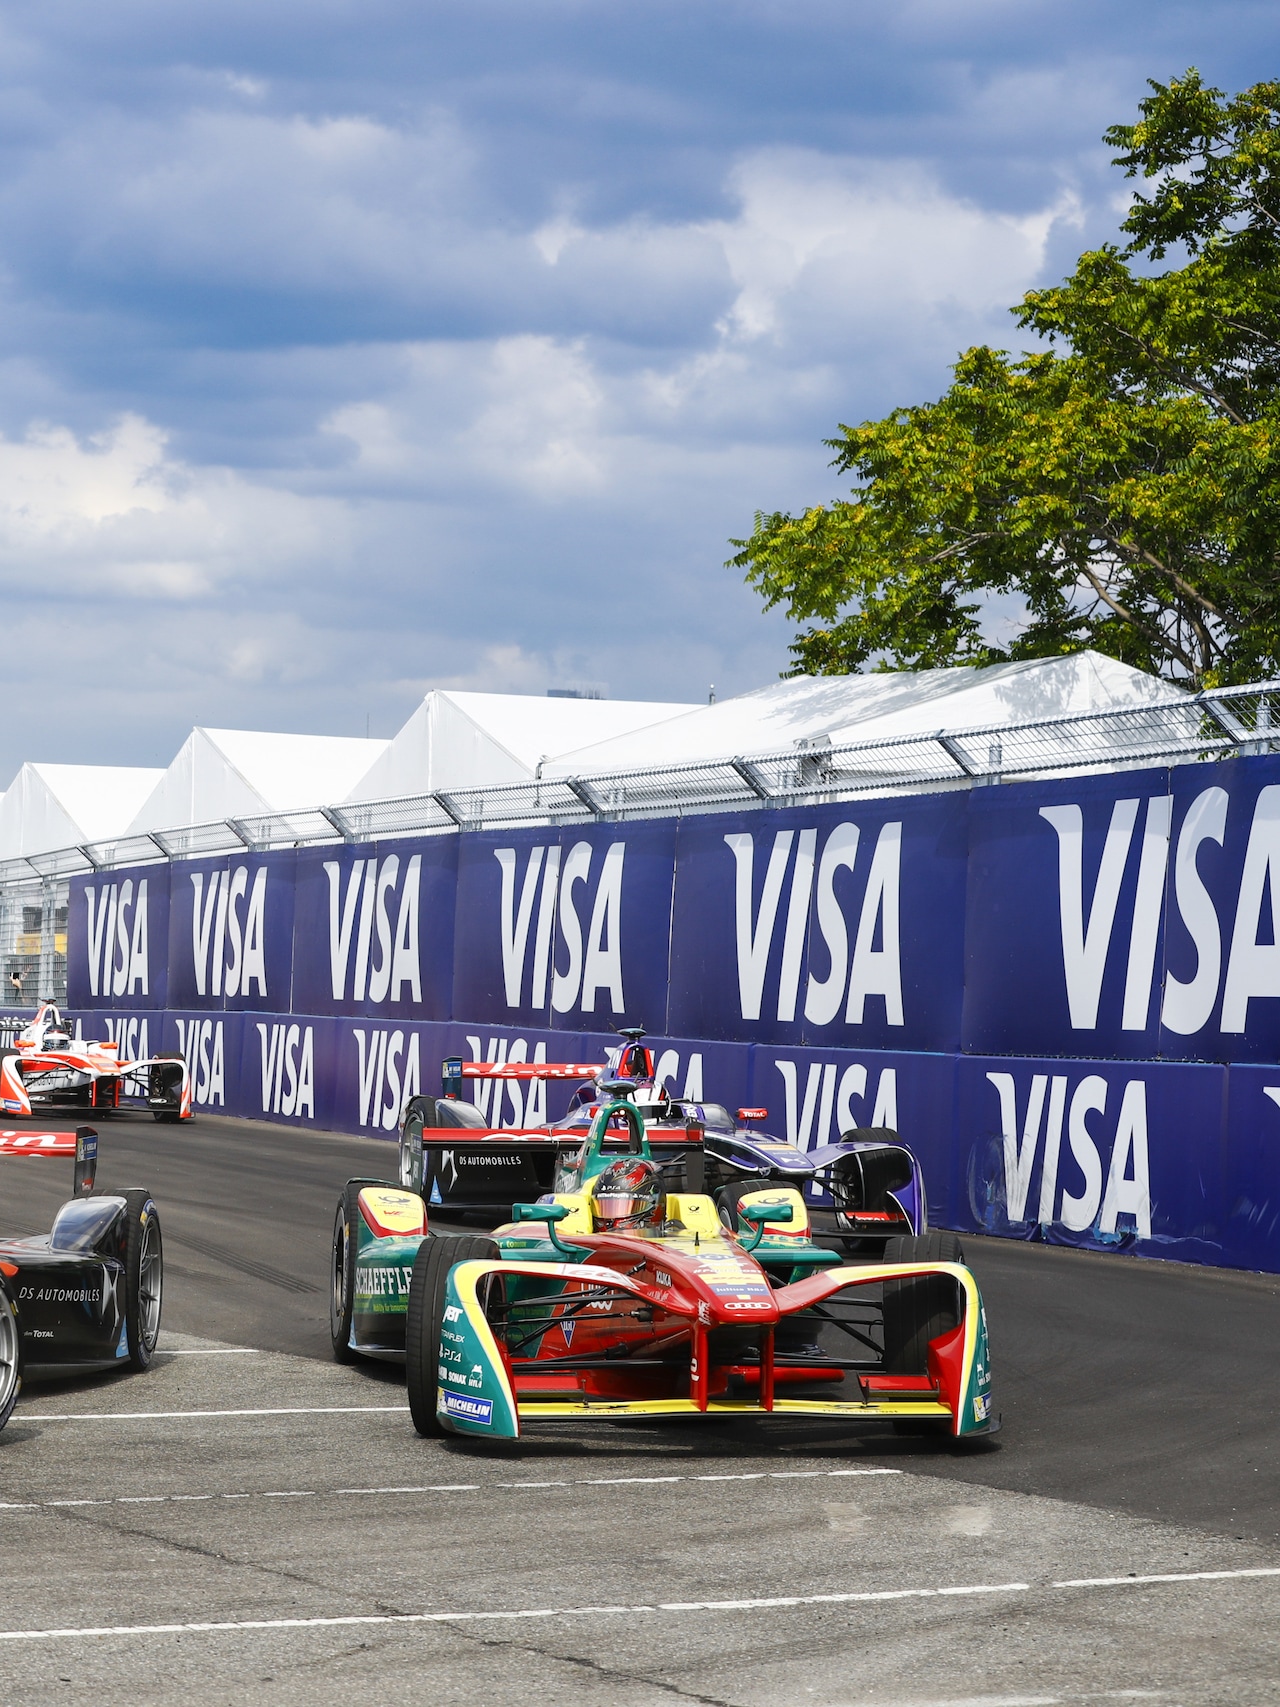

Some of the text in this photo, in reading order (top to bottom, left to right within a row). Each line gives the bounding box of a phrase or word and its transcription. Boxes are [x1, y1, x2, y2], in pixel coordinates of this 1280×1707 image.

[86, 879, 149, 996] VISA
[191, 866, 267, 998] VISA
[324, 854, 422, 1003] VISA
[494, 841, 625, 1014] VISA
[724, 822, 904, 1026] VISA
[1039, 786, 1280, 1034] VISA
[176, 1018, 225, 1107] VISA
[256, 1023, 314, 1118] VISA
[353, 1029, 420, 1131] VISA
[468, 1155, 522, 1166] AUTOMOBILES
[986, 1071, 1151, 1240] VISA
[19, 1286, 100, 1302] DS AUTOMOBILES
[33, 1329, 54, 1338] TOTAL
[442, 1305, 464, 1323] ABT
[444, 1348, 462, 1363] PS4
[447, 1397, 491, 1417] MICHELIN
